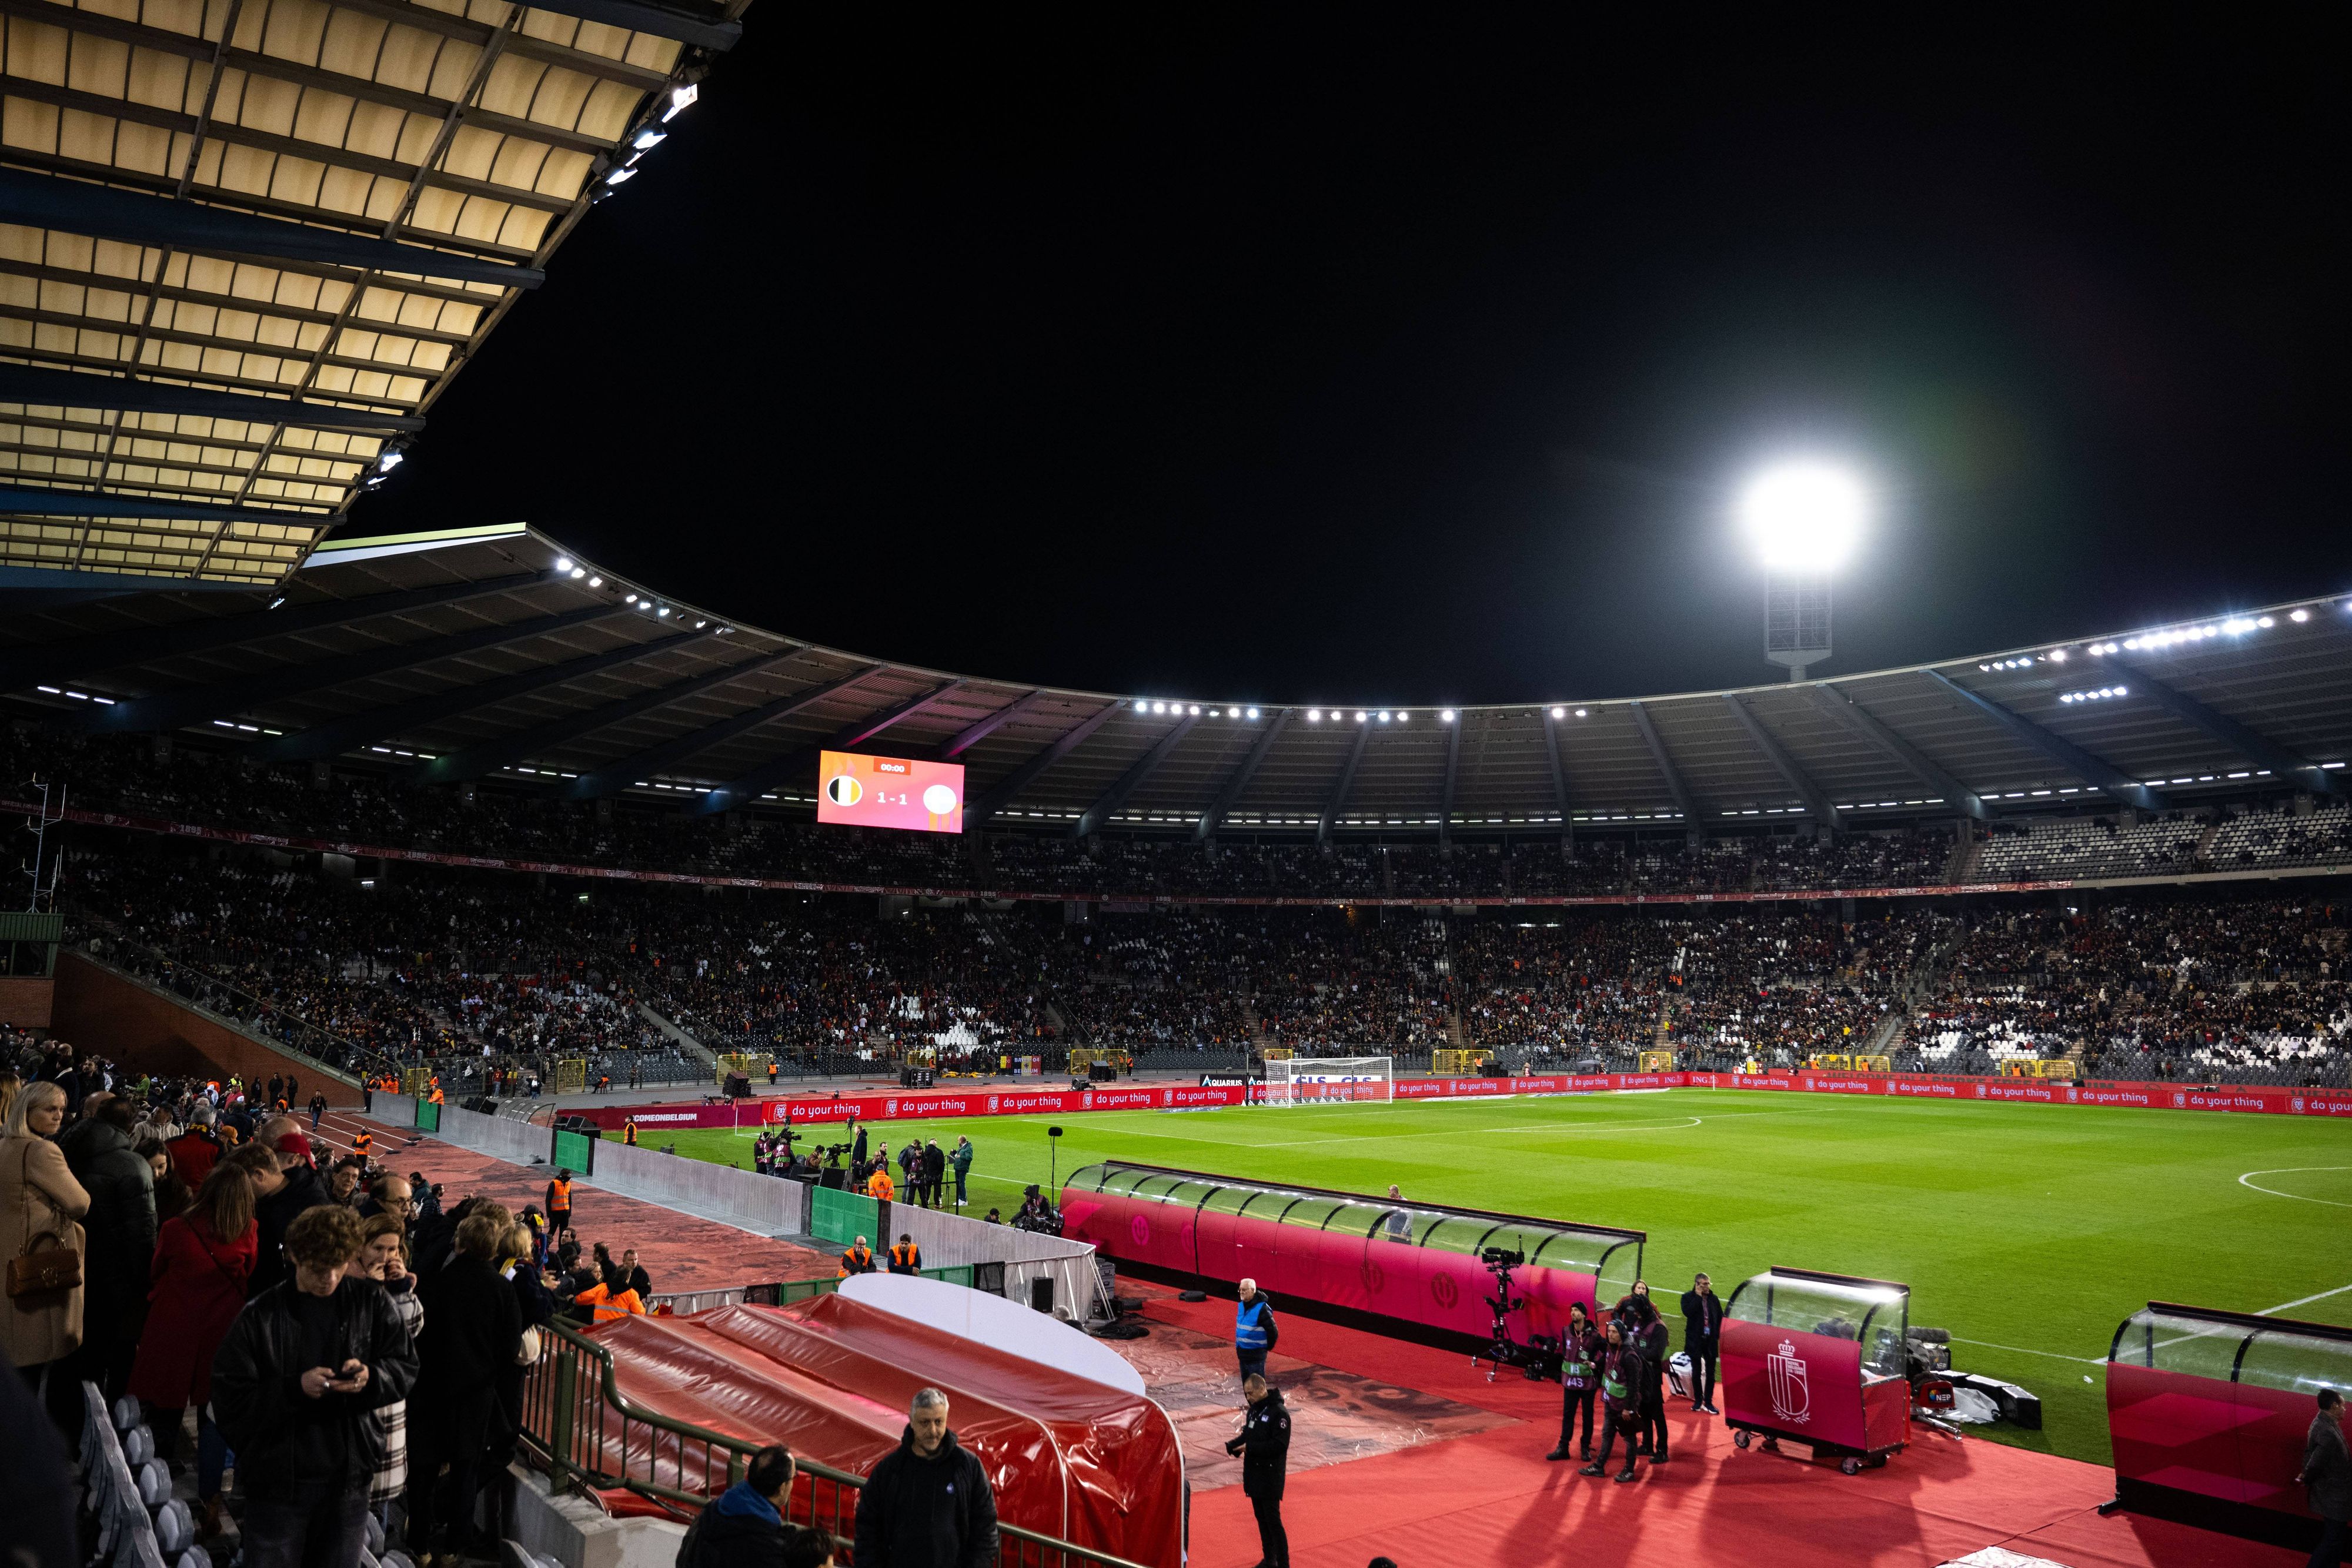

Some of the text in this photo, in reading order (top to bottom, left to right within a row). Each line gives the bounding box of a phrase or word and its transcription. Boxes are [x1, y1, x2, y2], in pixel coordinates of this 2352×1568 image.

[881, 764, 904, 772] 00:00
[878, 792, 886, 803] 1
[899, 794, 907, 805] 1
[1202, 1075, 1242, 1086] AQUARIUS
[1541, 1079, 1554, 1088] thing
[1595, 1078, 1608, 1086] thing
[1770, 1078, 1788, 1088] thing
[1847, 1081, 1867, 1091] thing
[1424, 1084, 1439, 1092] thing
[1482, 1082, 1496, 1091] thing
[1932, 1085, 1955, 1095] thing
[1177, 1091, 1227, 1102] do your thing
[1257, 1089, 1266, 1097] do
[2026, 1088, 2050, 1099] thing
[2083, 1091, 2094, 1099] do
[2122, 1092, 2147, 1104] thing
[1004, 1096, 1061, 1109] do your thing
[1097, 1093, 1150, 1105] do your thing
[2191, 1095, 2263, 1109] do your thing
[793, 1104, 860, 1118] do your thing
[903, 1099, 965, 1113] do your thing
[2311, 1100, 2352, 1112] do you
[633, 1114, 697, 1122] COMEONBELGIUM
